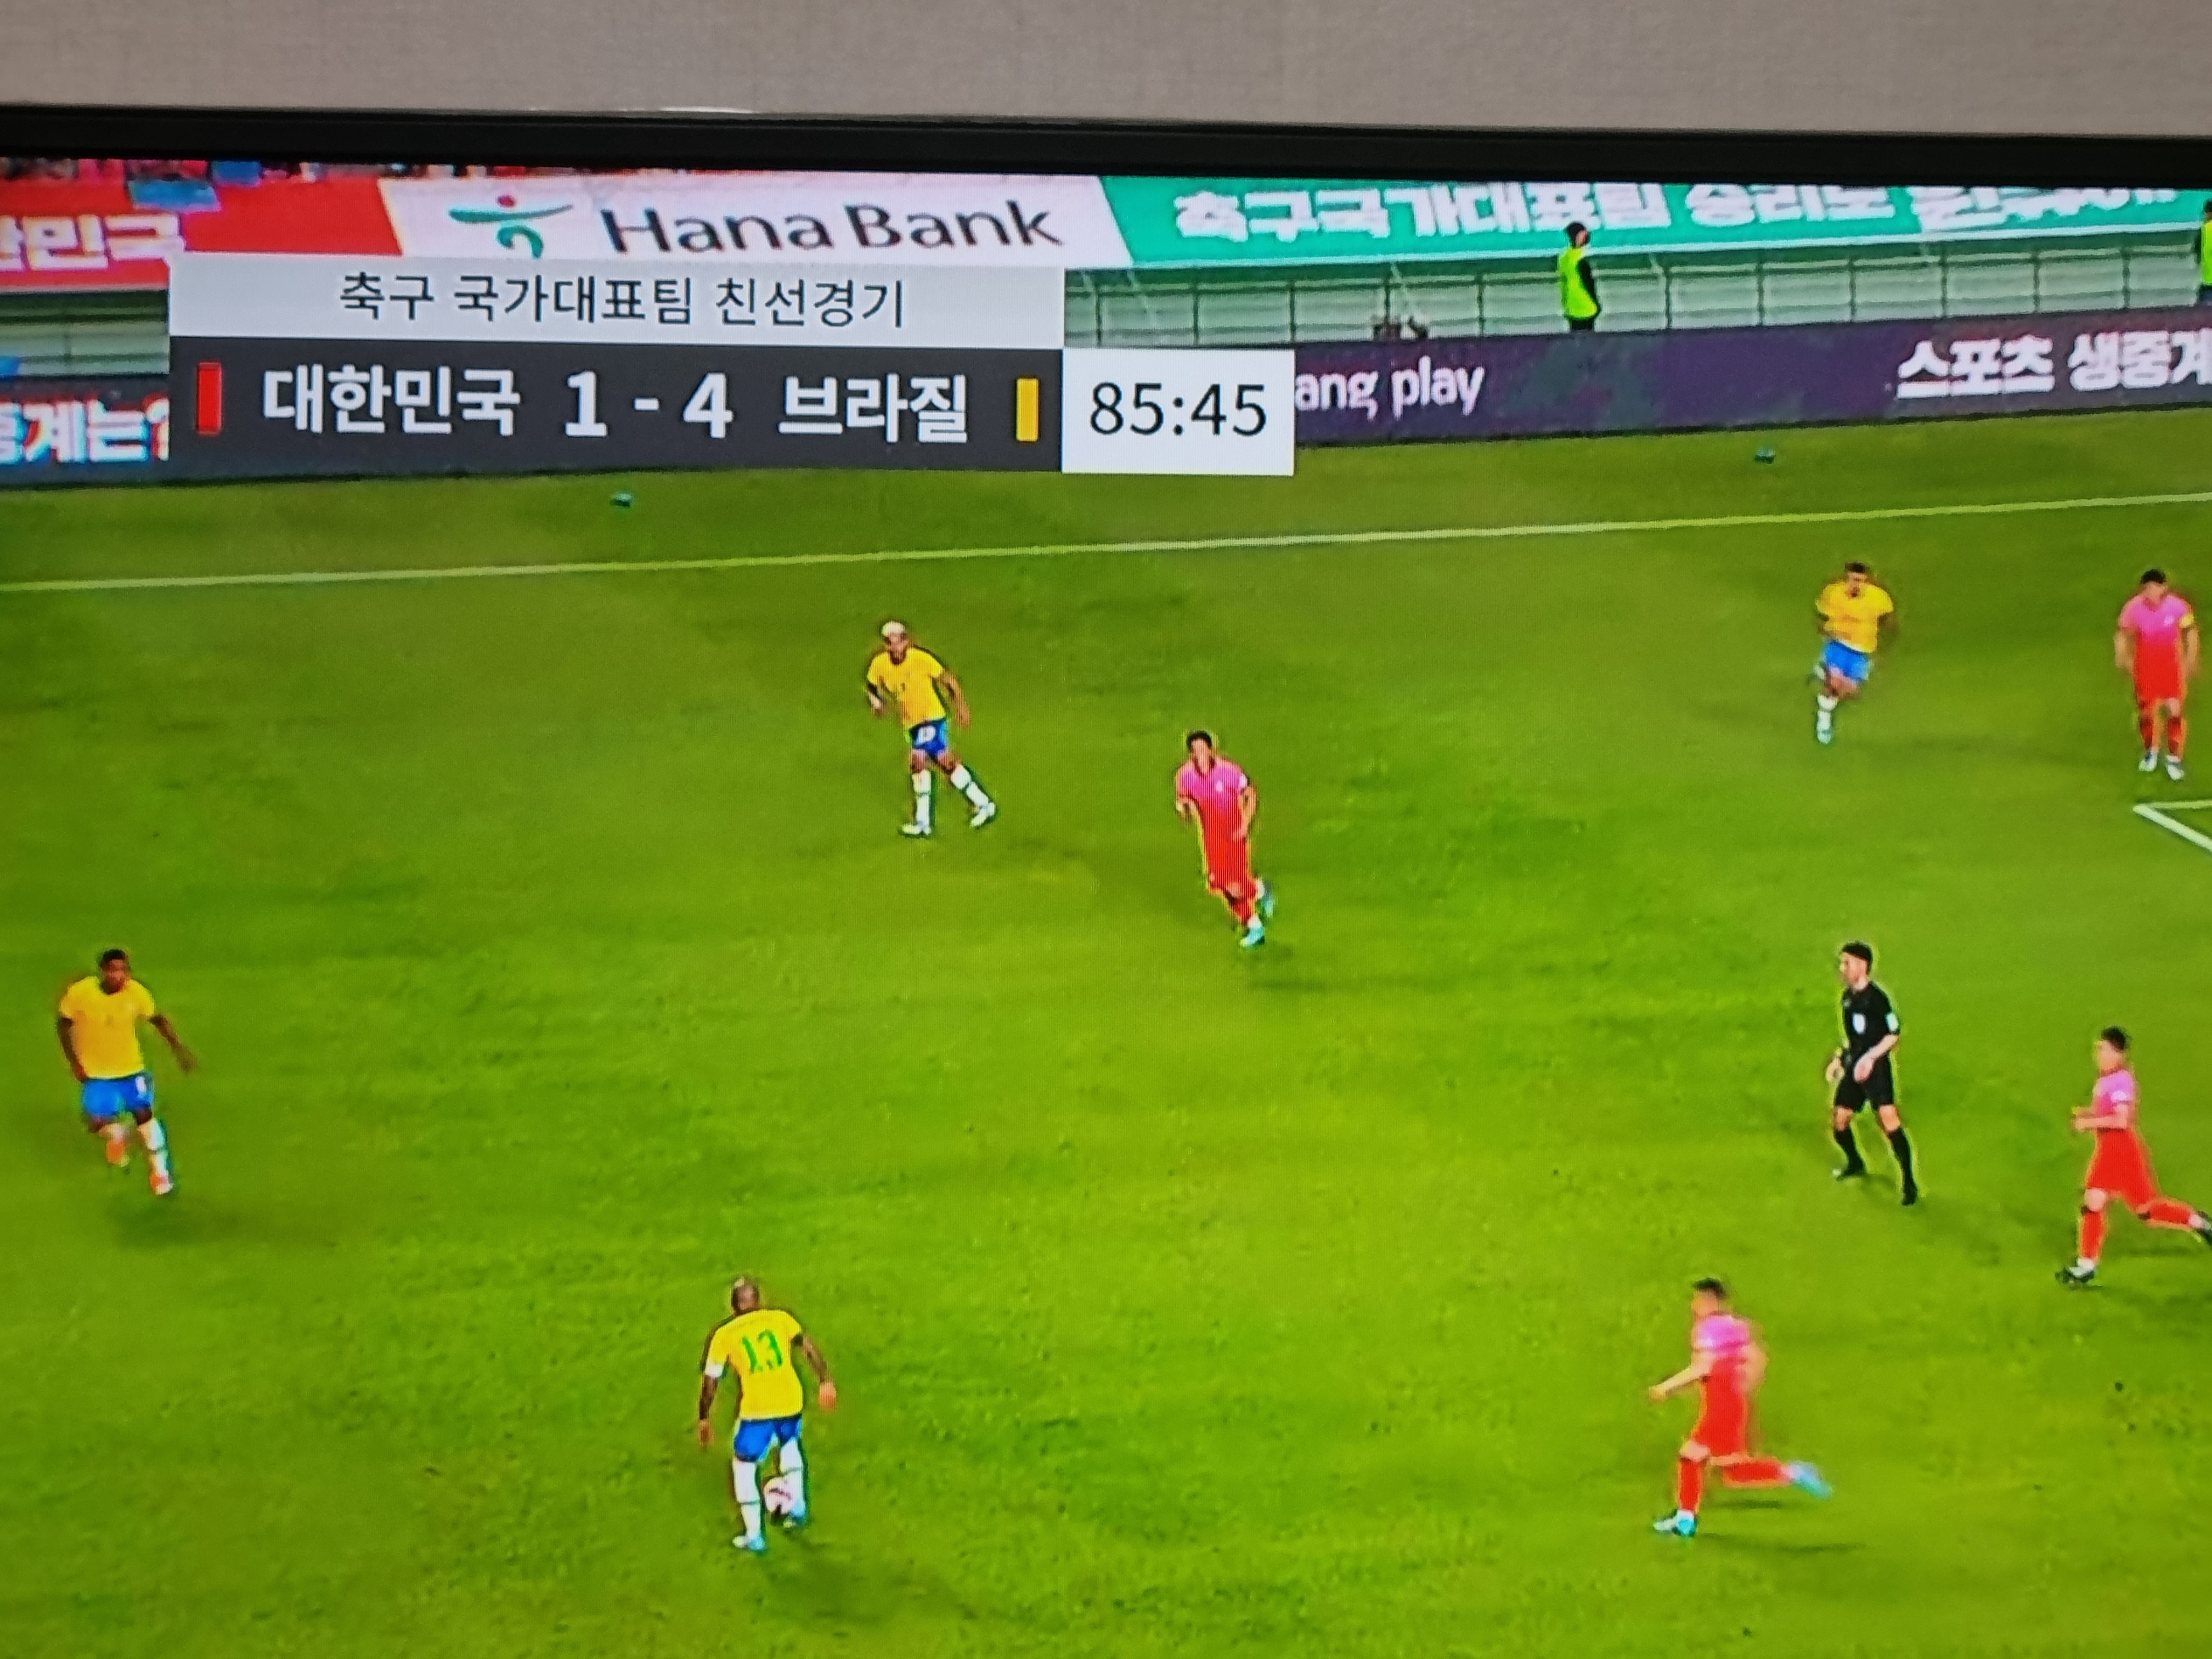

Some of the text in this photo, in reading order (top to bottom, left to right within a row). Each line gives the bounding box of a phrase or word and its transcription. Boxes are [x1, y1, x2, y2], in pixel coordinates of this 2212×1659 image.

[601, 200, 1063, 253] Hana Bank
[340, 272, 902, 328] 축구 국가대표팀 친선경기
[1391, 354, 1485, 421] play
[1897, 334, 2055, 400] 스포츠
[263, 363, 521, 437] 대한민국
[565, 370, 607, 437] 1
[682, 371, 733, 439] 4
[778, 373, 968, 443] 브라질
[1090, 381, 1267, 437] 85:45
[741, 1328, 783, 1373] 13
